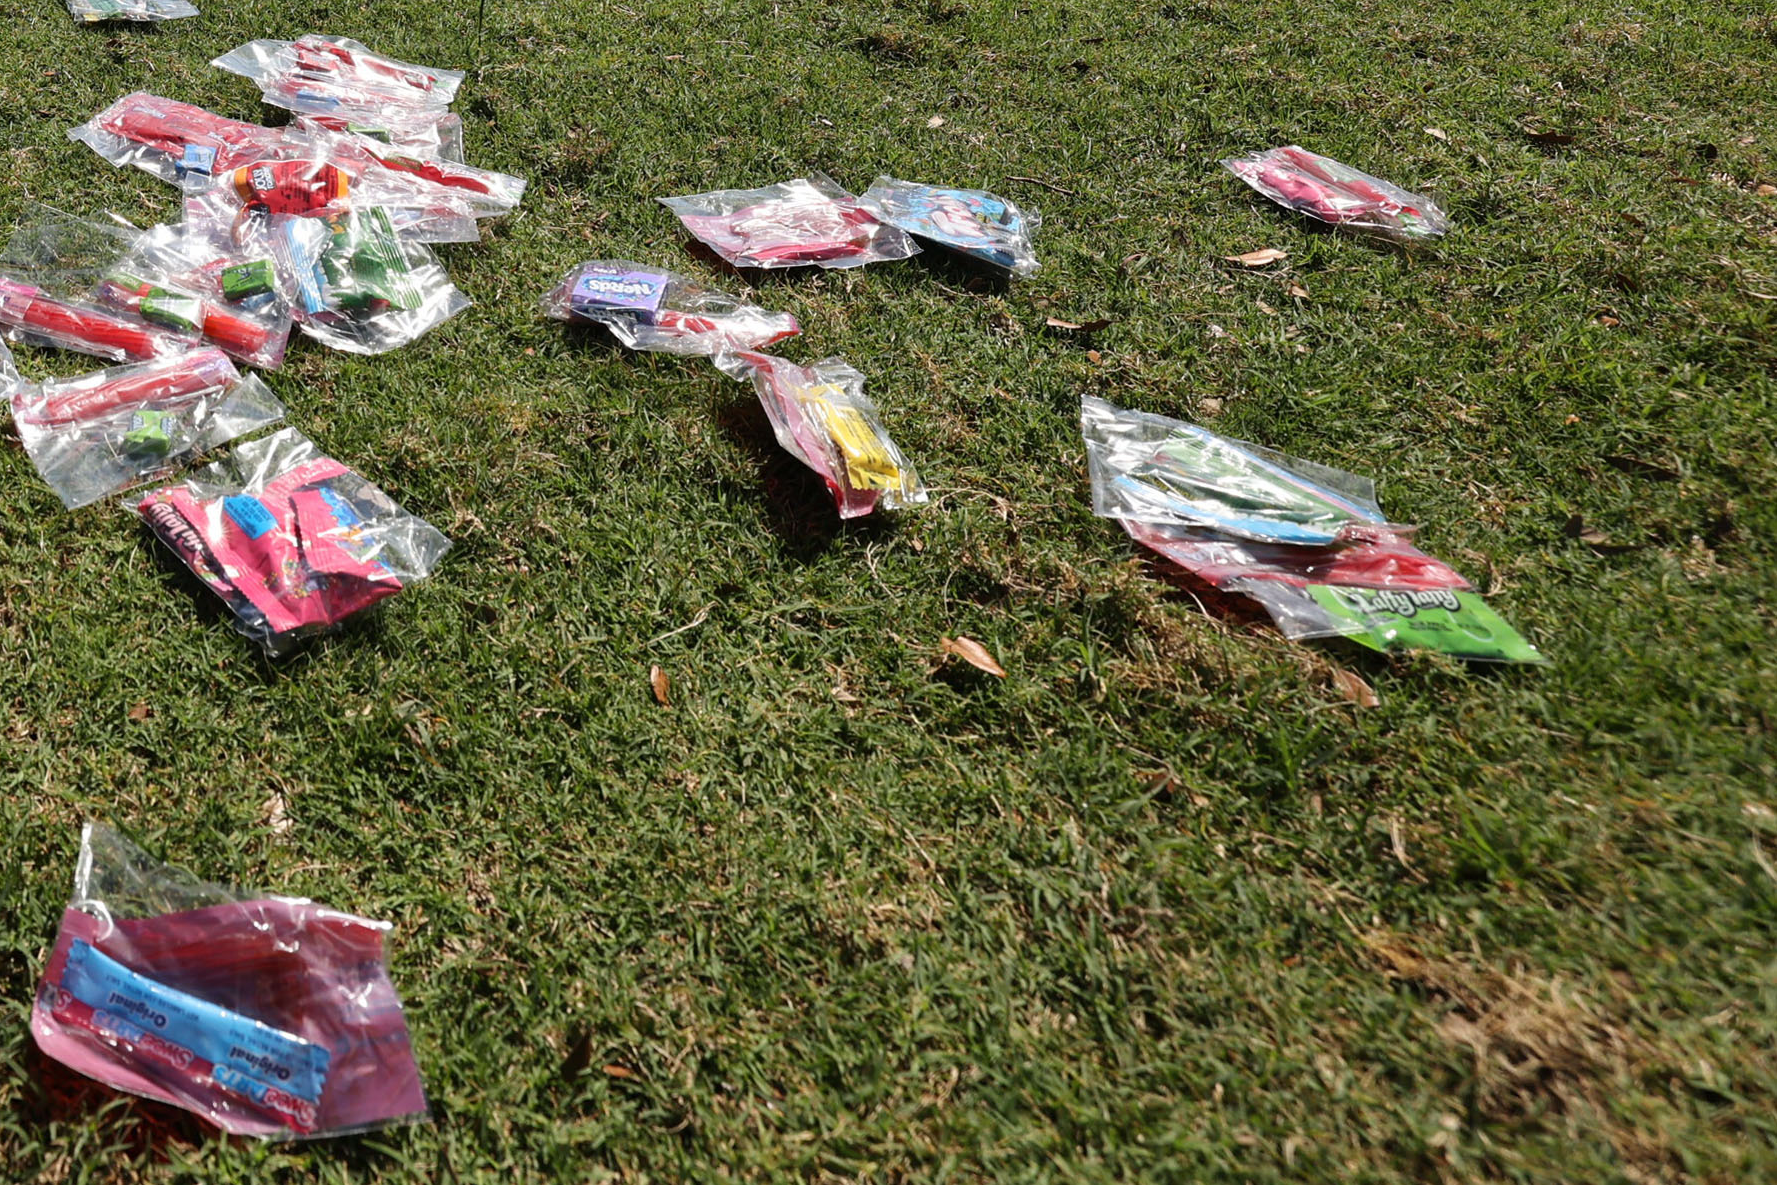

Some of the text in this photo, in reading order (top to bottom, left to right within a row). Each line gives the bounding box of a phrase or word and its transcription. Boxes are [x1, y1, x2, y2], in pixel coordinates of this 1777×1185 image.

[108, 991, 168, 1028] Original
[91, 1009, 195, 1071] SweeTARTS
[229, 1046, 291, 1081] Original
[212, 1063, 318, 1127] SweeTARTS
